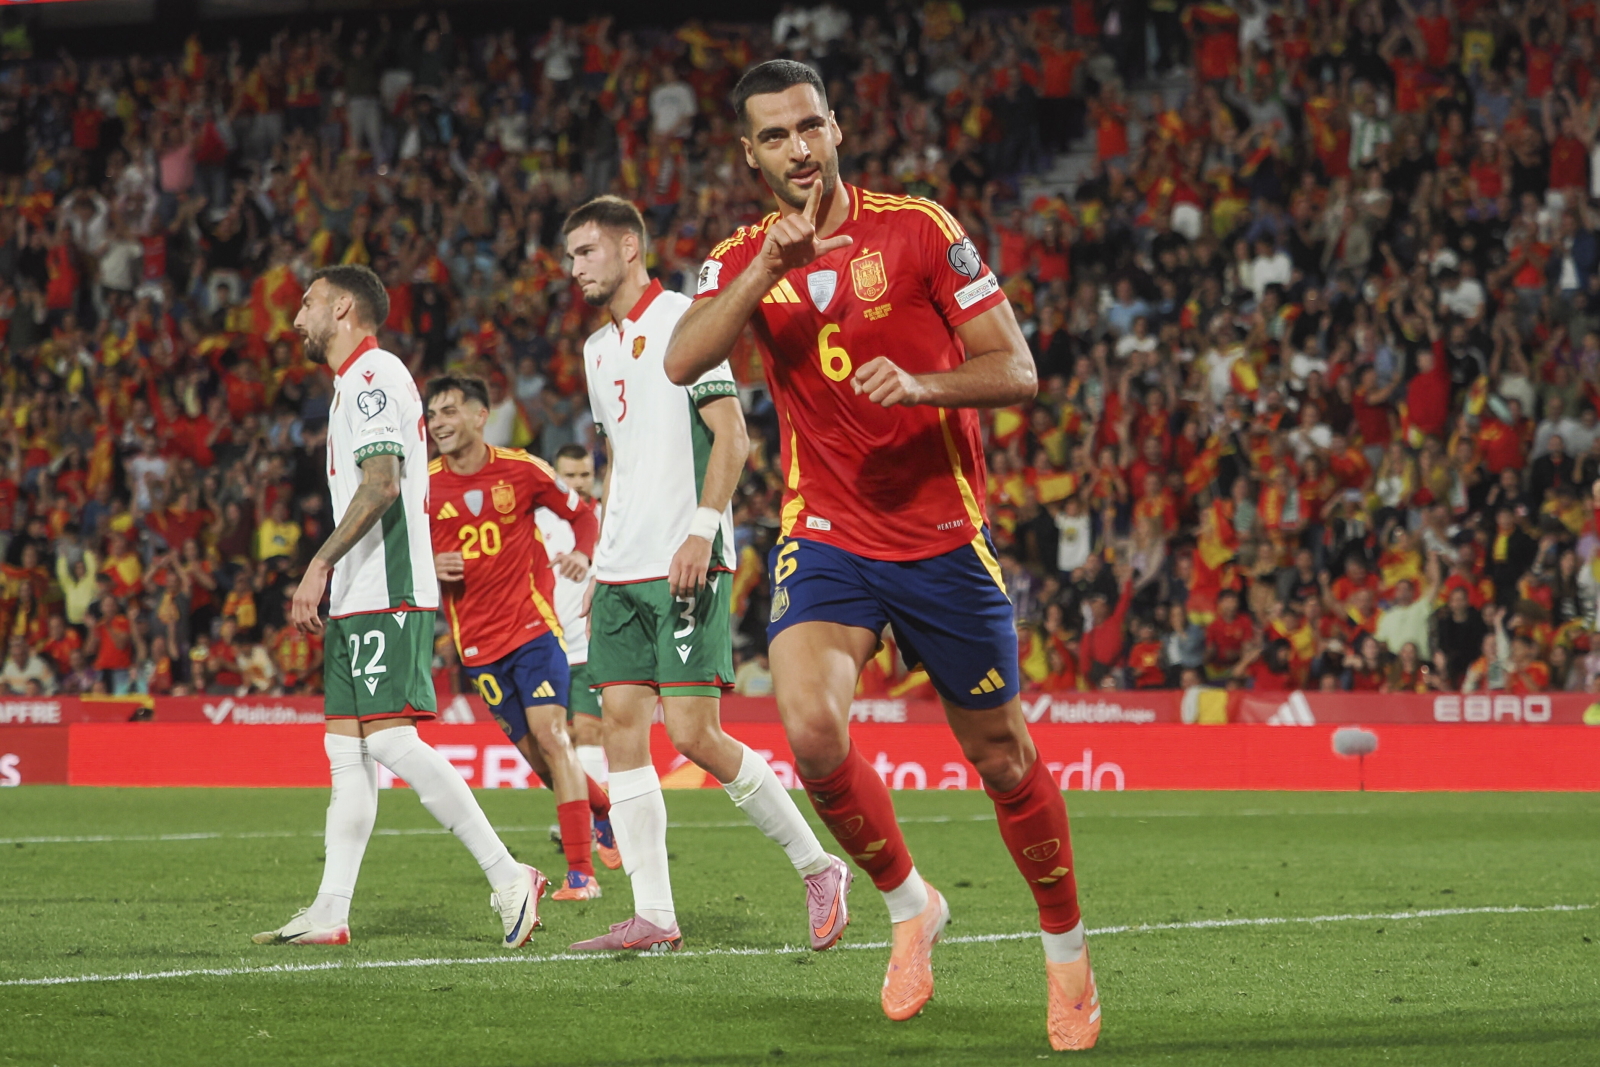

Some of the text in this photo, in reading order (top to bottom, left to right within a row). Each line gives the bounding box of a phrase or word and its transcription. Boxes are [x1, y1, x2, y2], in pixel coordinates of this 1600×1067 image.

[818, 323, 852, 382] 6
[614, 379, 627, 423] 3
[458, 520, 501, 560] 20
[774, 541, 800, 584] 6
[673, 595, 696, 639] 3
[349, 629, 387, 678] 22
